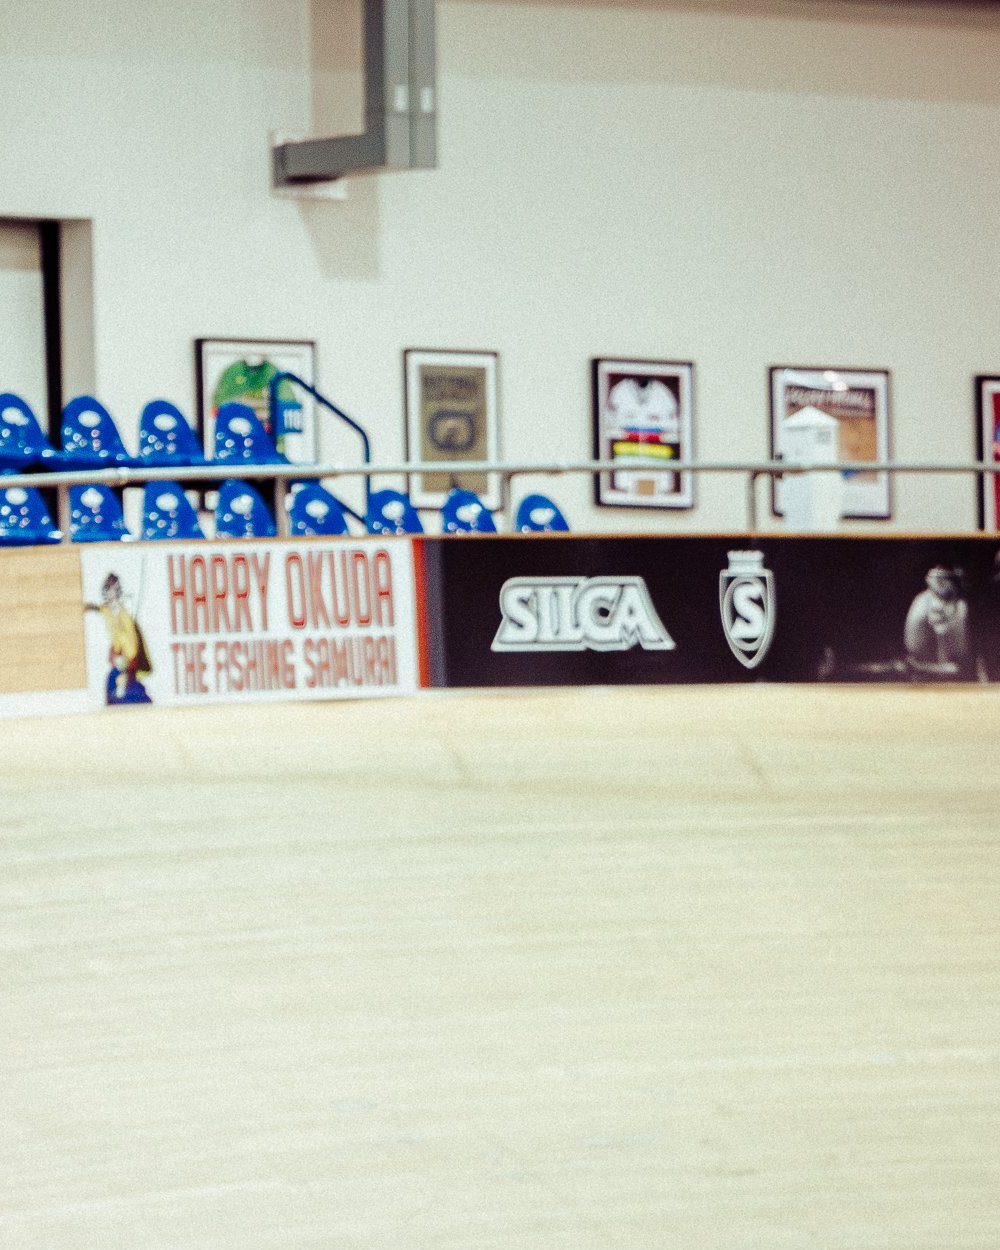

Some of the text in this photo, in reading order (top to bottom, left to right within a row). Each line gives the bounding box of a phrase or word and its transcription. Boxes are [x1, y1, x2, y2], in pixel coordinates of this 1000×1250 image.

[168, 549, 395, 634] HARRY OKUDA
[496, 581, 666, 646] SILCA
[171, 635, 398, 694] THE FISHING SAMURAI
